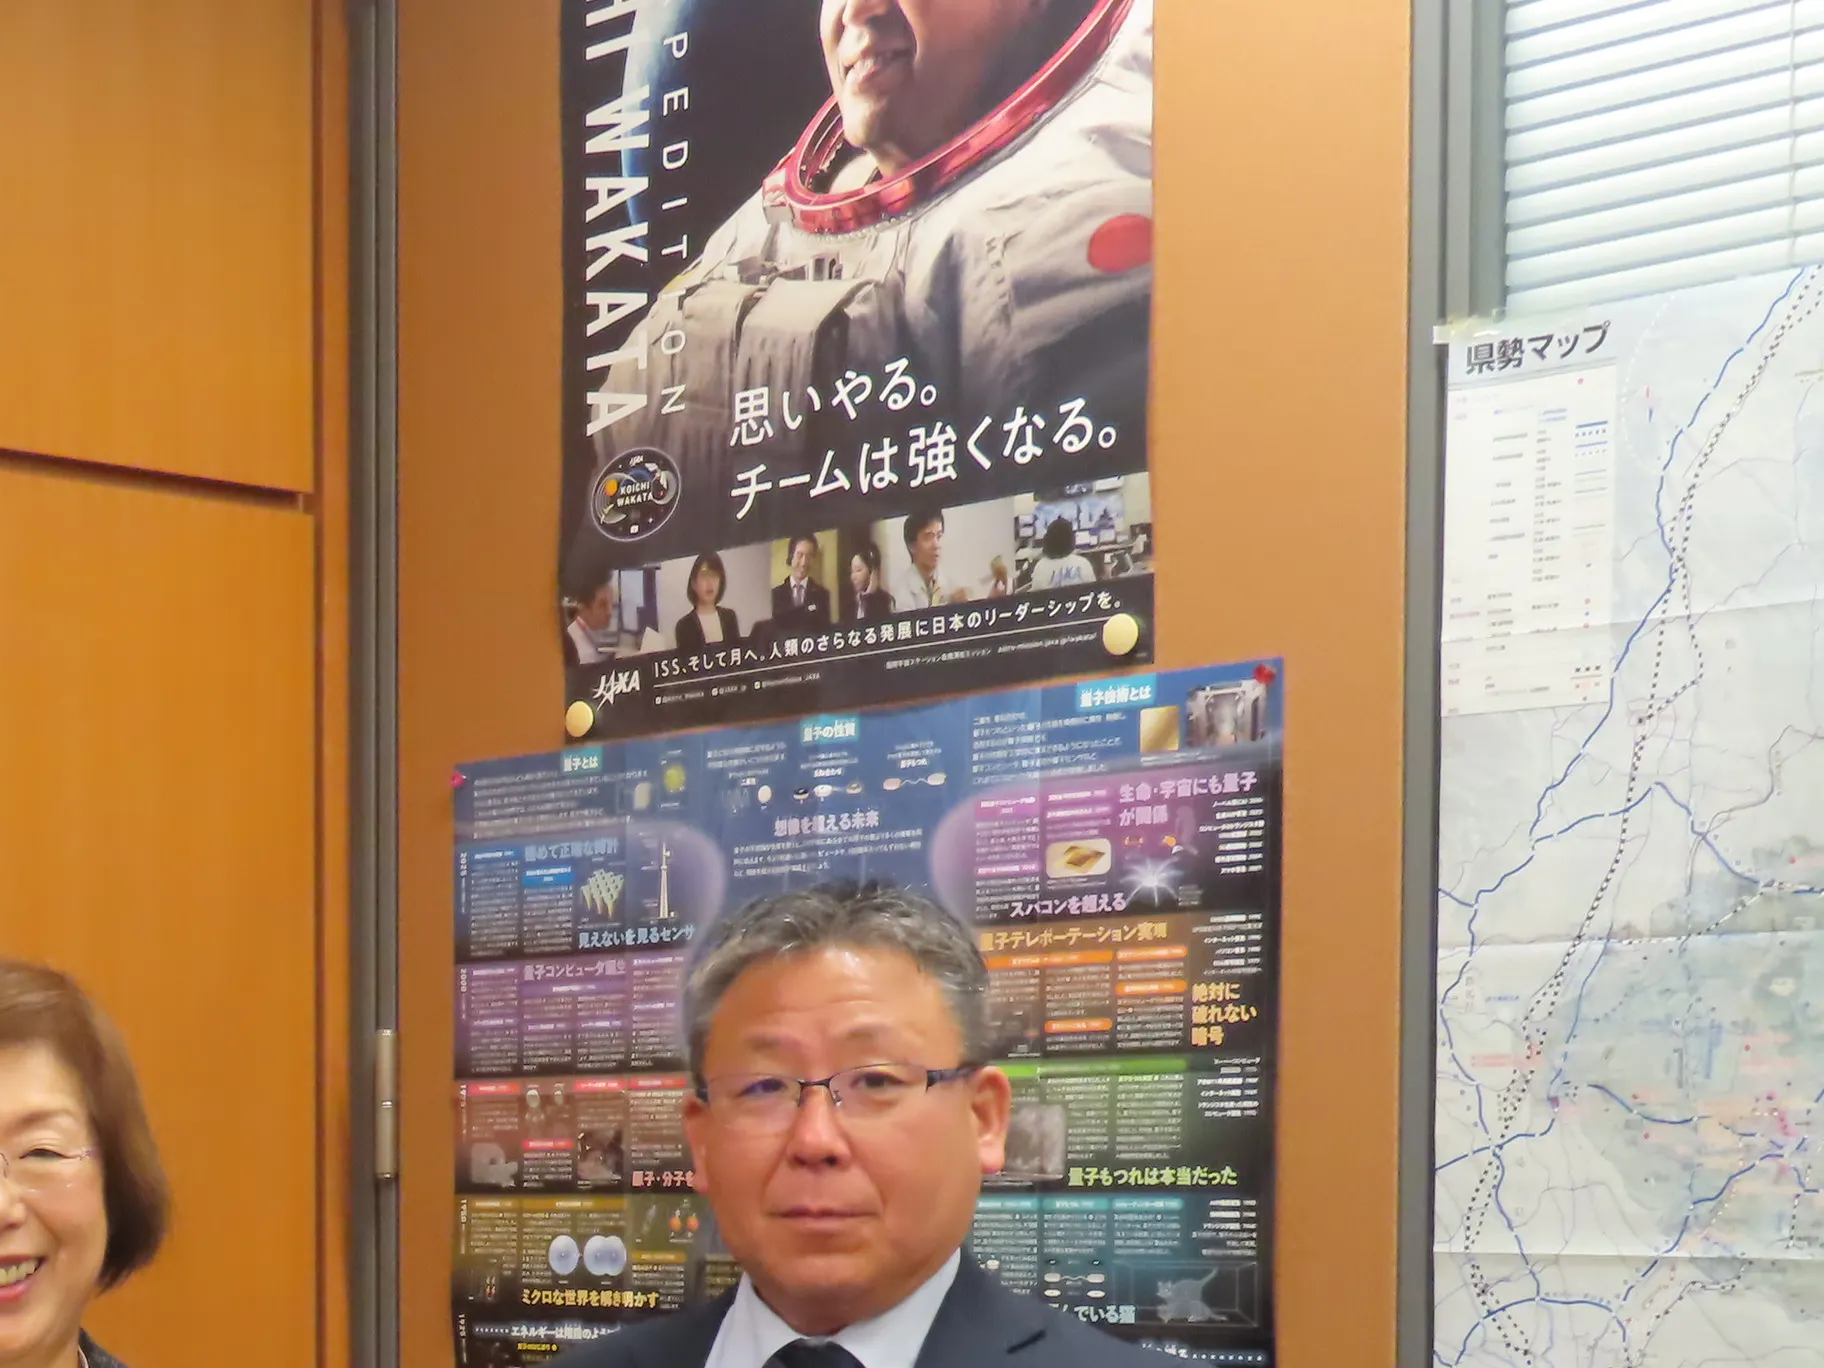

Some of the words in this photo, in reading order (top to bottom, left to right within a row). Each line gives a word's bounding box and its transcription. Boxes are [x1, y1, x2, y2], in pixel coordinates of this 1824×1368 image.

[662, 31, 689, 414] PEDITION
[586, 84, 650, 436] WAKATA
[1466, 319, 1612, 375] 県勢マップ
[729, 357, 937, 448] 思いやる。
[620, 481, 650, 495] KOICHI
[730, 397, 1117, 520] チームは強くなる。
[617, 491, 654, 507] WAKATA
[654, 590, 1121, 678] ISS、そして月へ。人類のさらなる発展に日本のリーダーシップを。
[593, 670, 640, 710] JAXA
[1068, 1166, 1238, 1188] 量子もつれは本当だった
